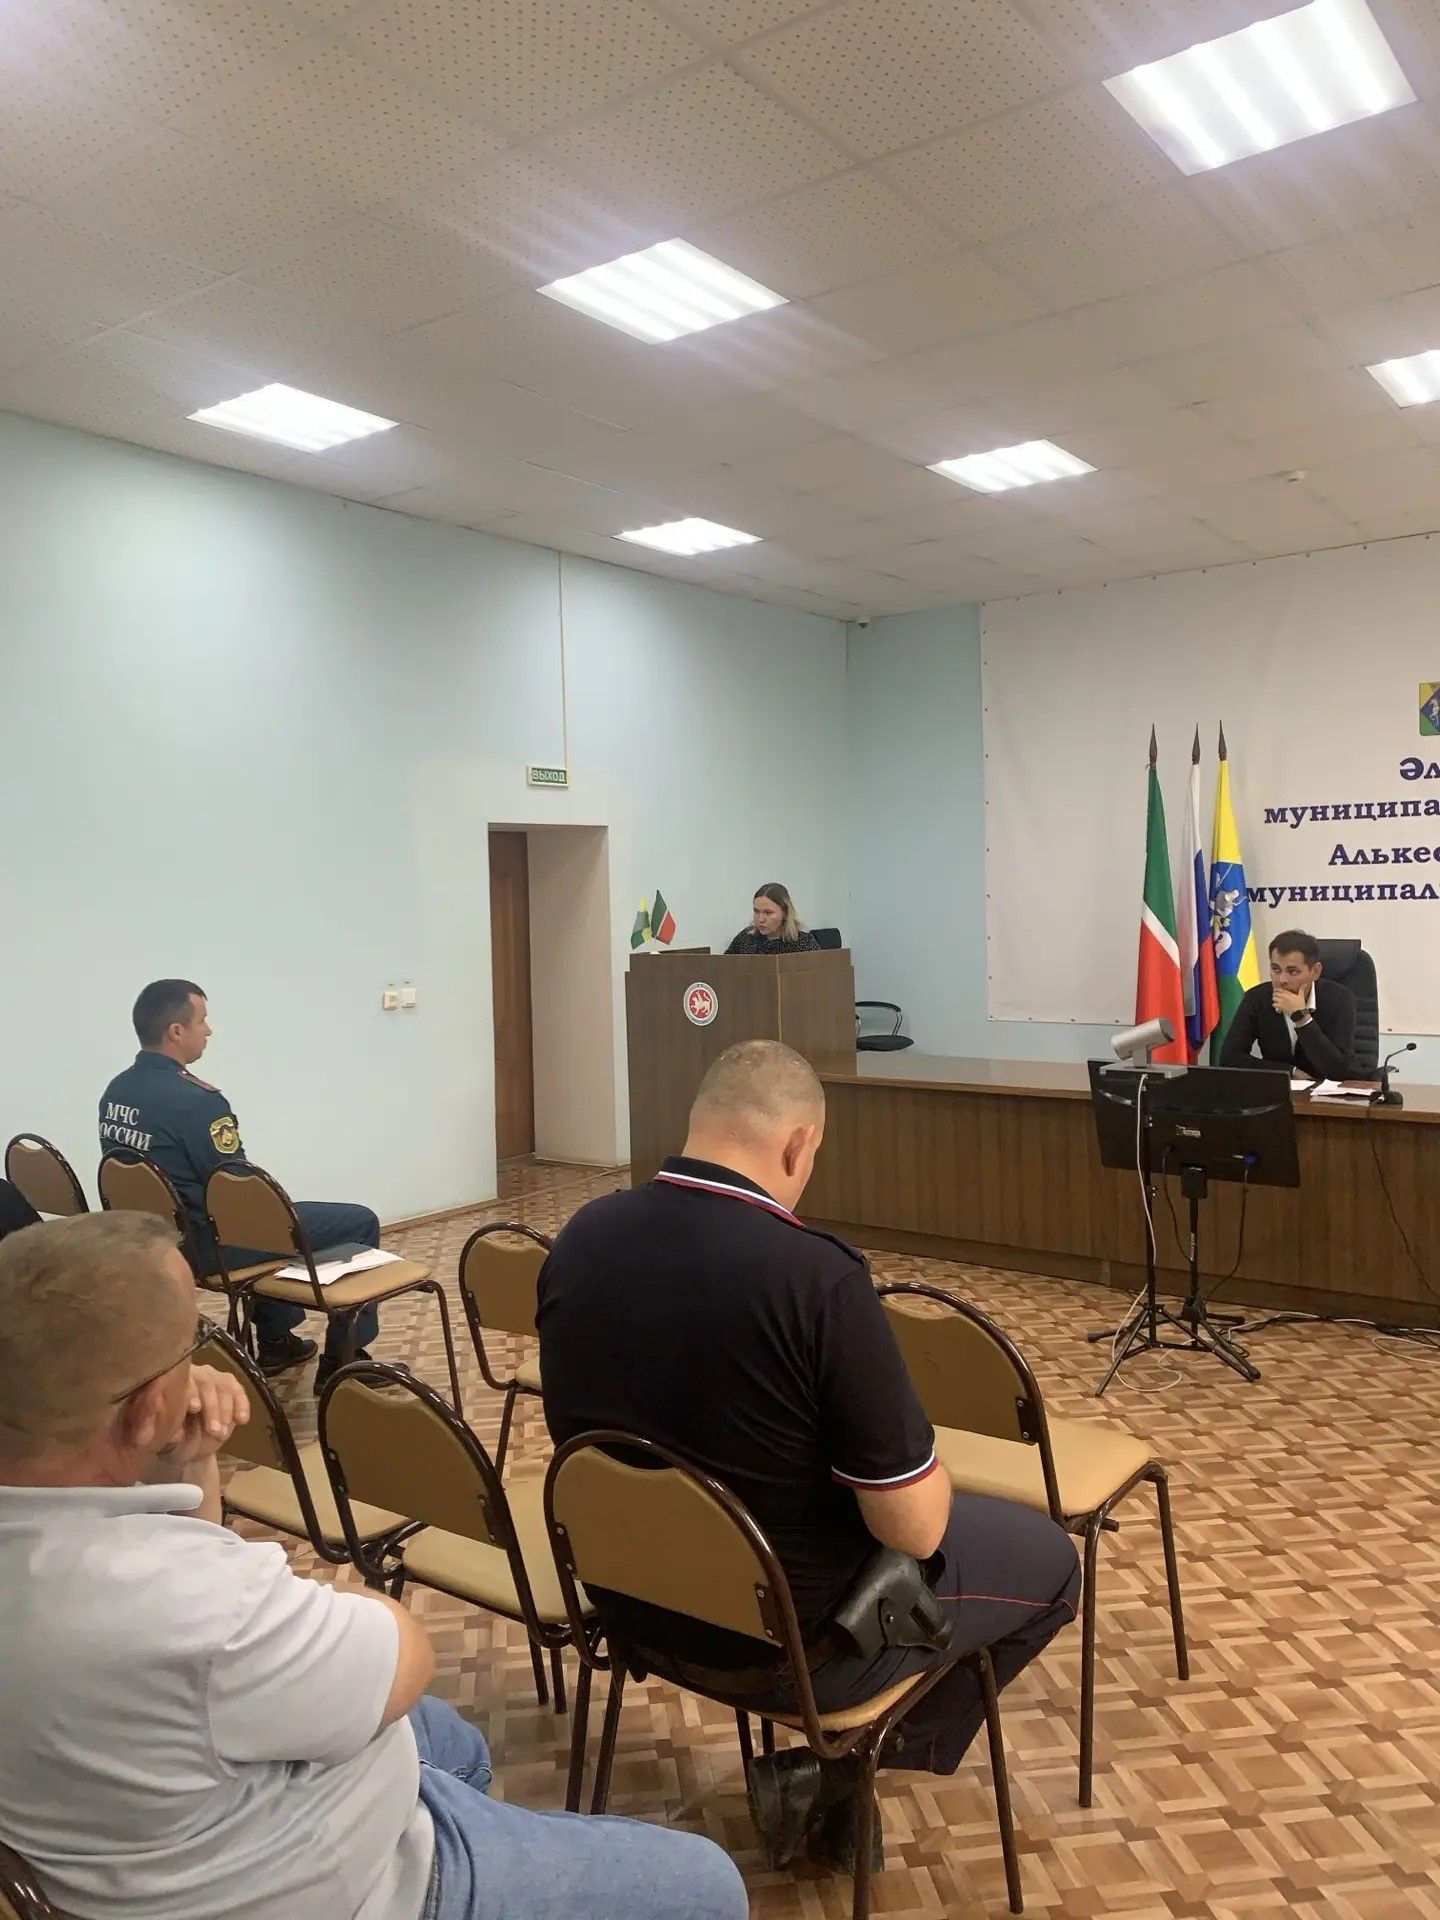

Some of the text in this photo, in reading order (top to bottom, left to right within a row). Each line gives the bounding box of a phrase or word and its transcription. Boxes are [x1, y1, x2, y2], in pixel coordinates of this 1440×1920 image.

[532, 769, 565, 782] ВЫХОД
[1264, 798, 1440, 829] муниципа
[1246, 883, 1440, 909] муниципал
[105, 1102, 140, 1126] МЧС
[100, 1122, 153, 1152] ОССИИ
